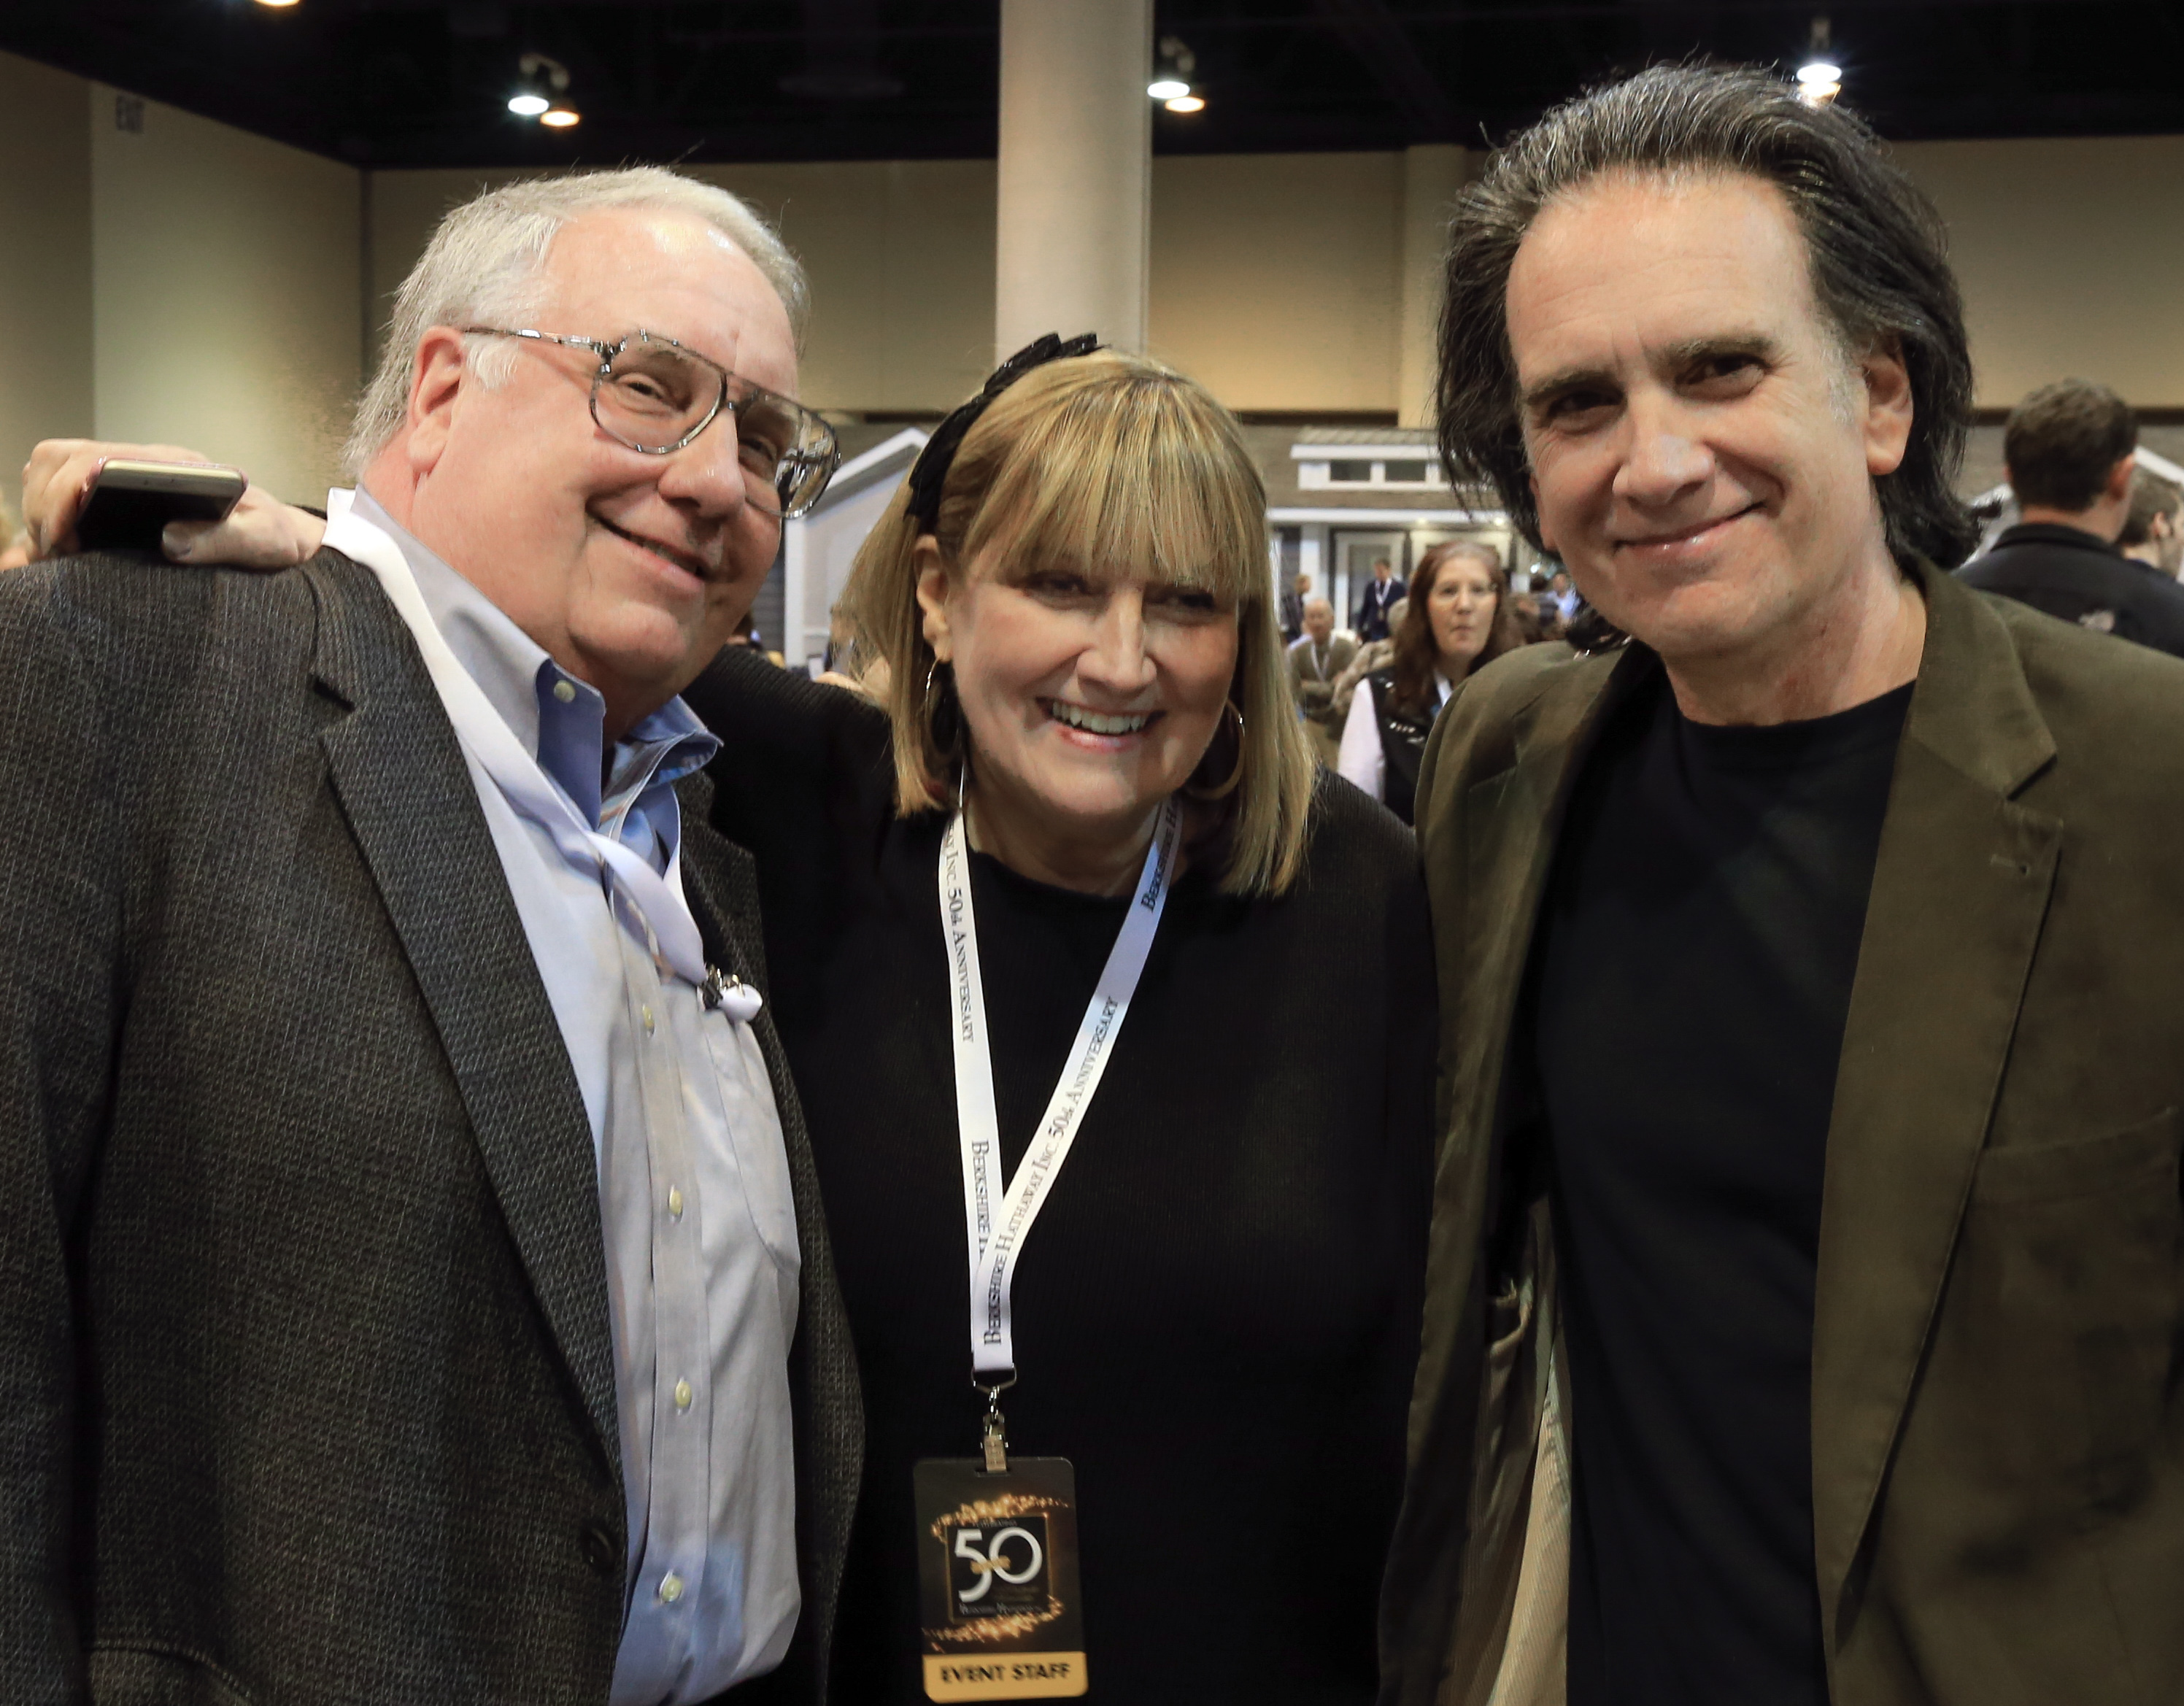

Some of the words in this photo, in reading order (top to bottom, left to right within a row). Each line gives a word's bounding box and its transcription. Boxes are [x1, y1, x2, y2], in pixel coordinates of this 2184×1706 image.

[952, 929, 975, 1043] ANNIVERSARY
[1065, 995, 1119, 1105] ANNIVERSARY
[971, 1138, 990, 1235] BERKSHIRE
[994, 1173, 1043, 1254] HATHAWAY
[984, 1254, 1008, 1346] BERKSHIRE
[954, 1526, 1043, 1603] 50
[941, 1664, 1006, 1683] EVENT
[1012, 1662, 1070, 1680] STAFF
